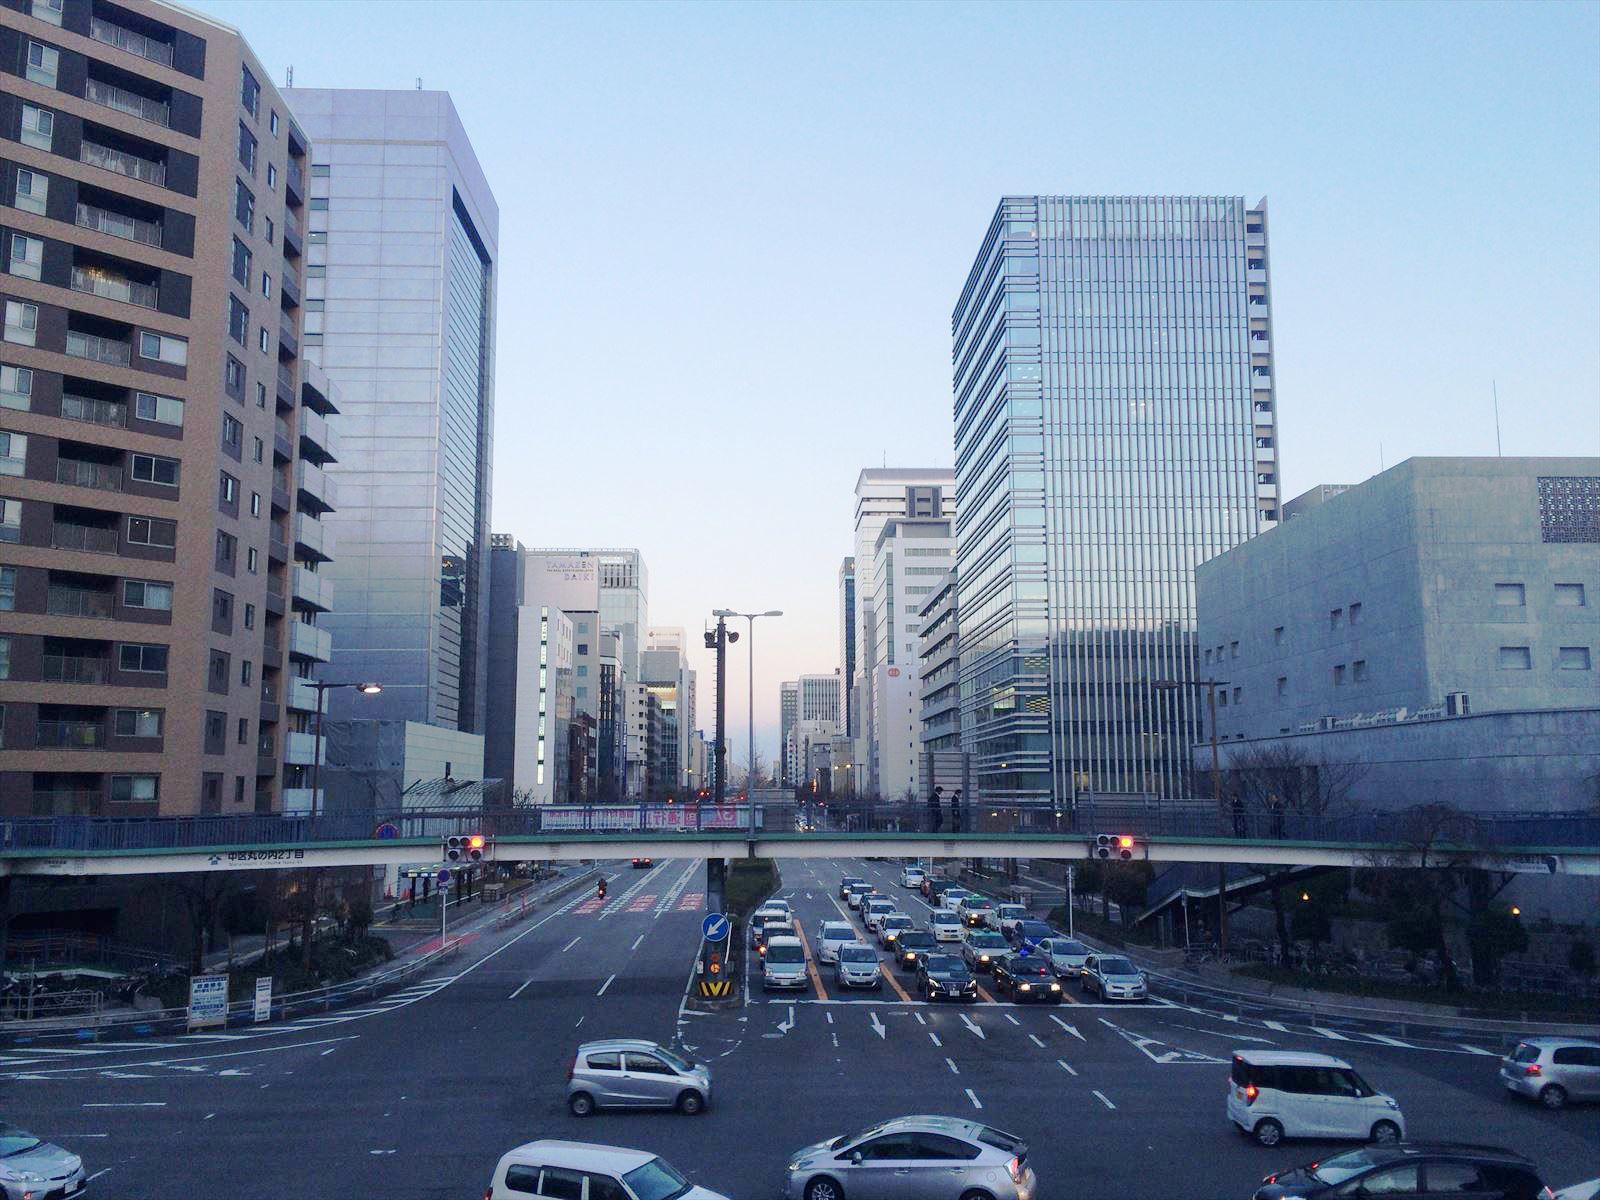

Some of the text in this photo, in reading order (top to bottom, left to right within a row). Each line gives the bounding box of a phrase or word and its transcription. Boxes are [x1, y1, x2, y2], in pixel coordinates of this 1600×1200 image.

[564, 573, 594, 581] DAIKI
[228, 849, 304, 861] 中区丸の内2丁目
